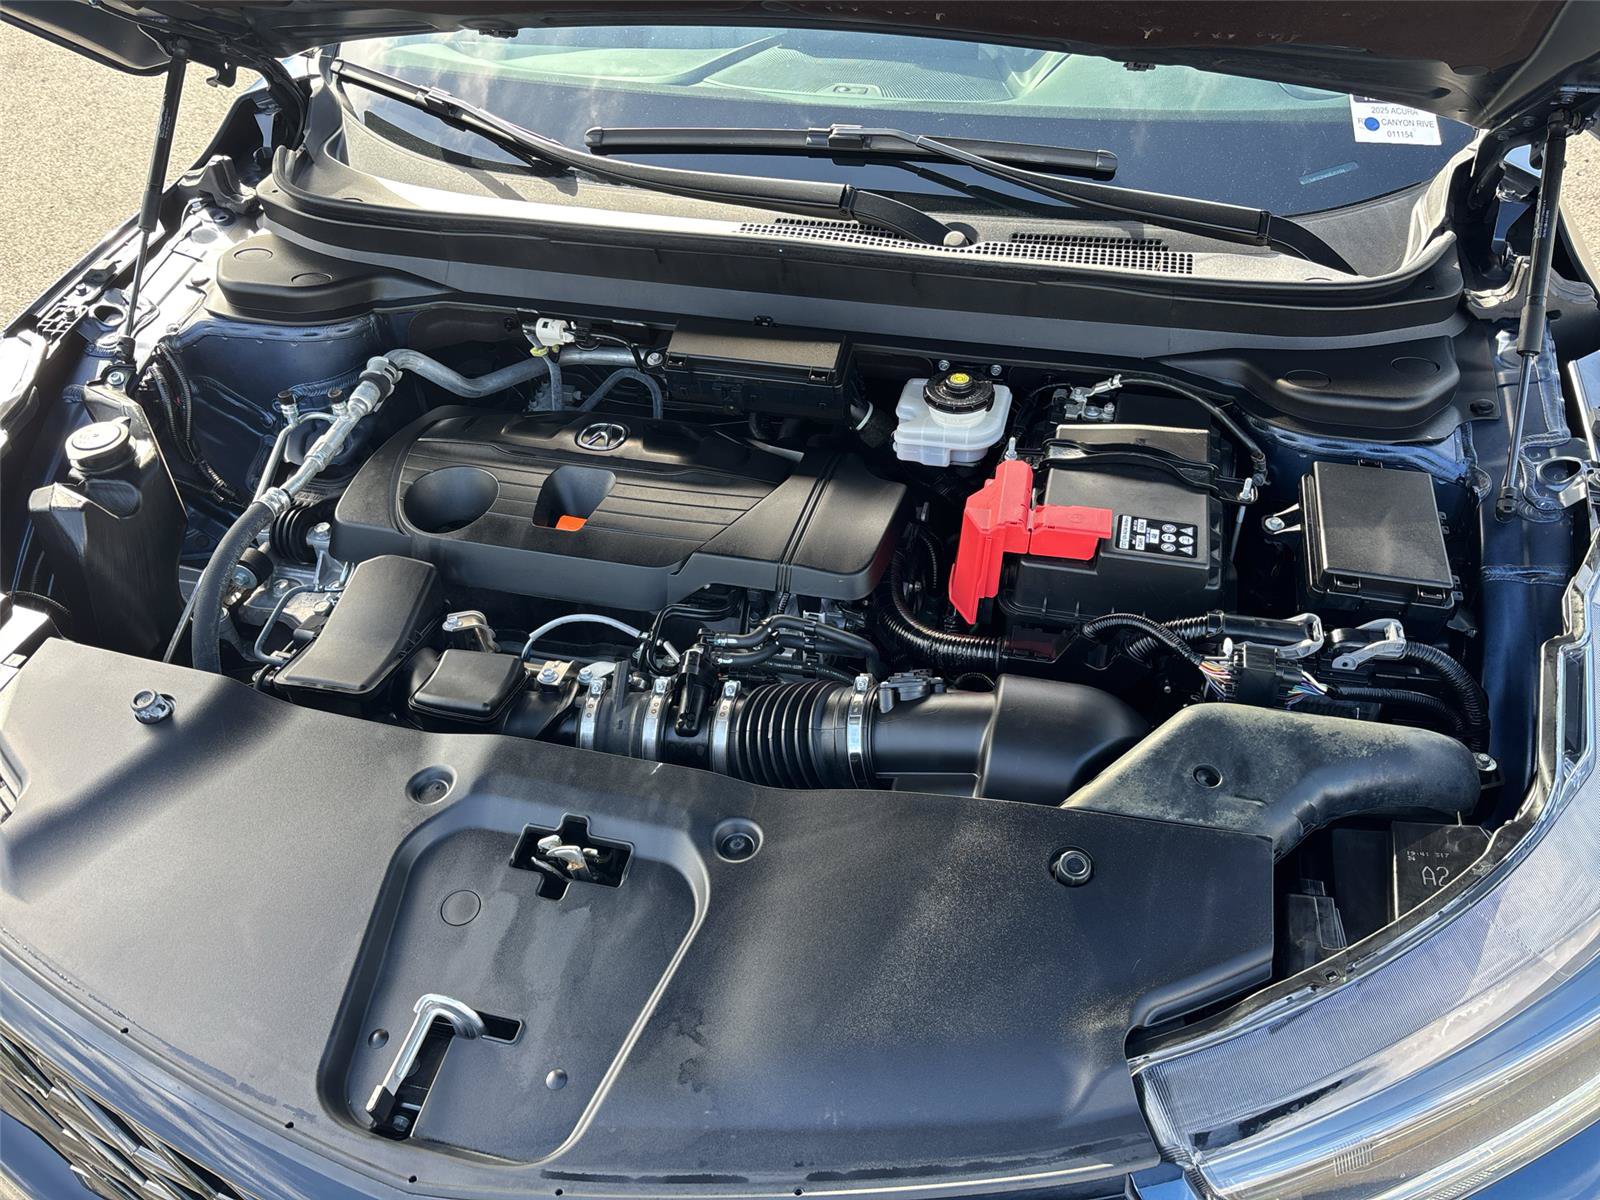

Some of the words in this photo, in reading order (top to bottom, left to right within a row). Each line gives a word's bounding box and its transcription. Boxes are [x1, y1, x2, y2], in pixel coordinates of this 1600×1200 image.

[1371, 106, 1390, 114] 2025
[1391, 107, 1419, 116] ACURA
[1381, 118, 1415, 127] CANYON
[1416, 120, 1435, 129] RIVE
[1386, 130, 1414, 138] 011154
[1421, 866, 1449, 887] A2
